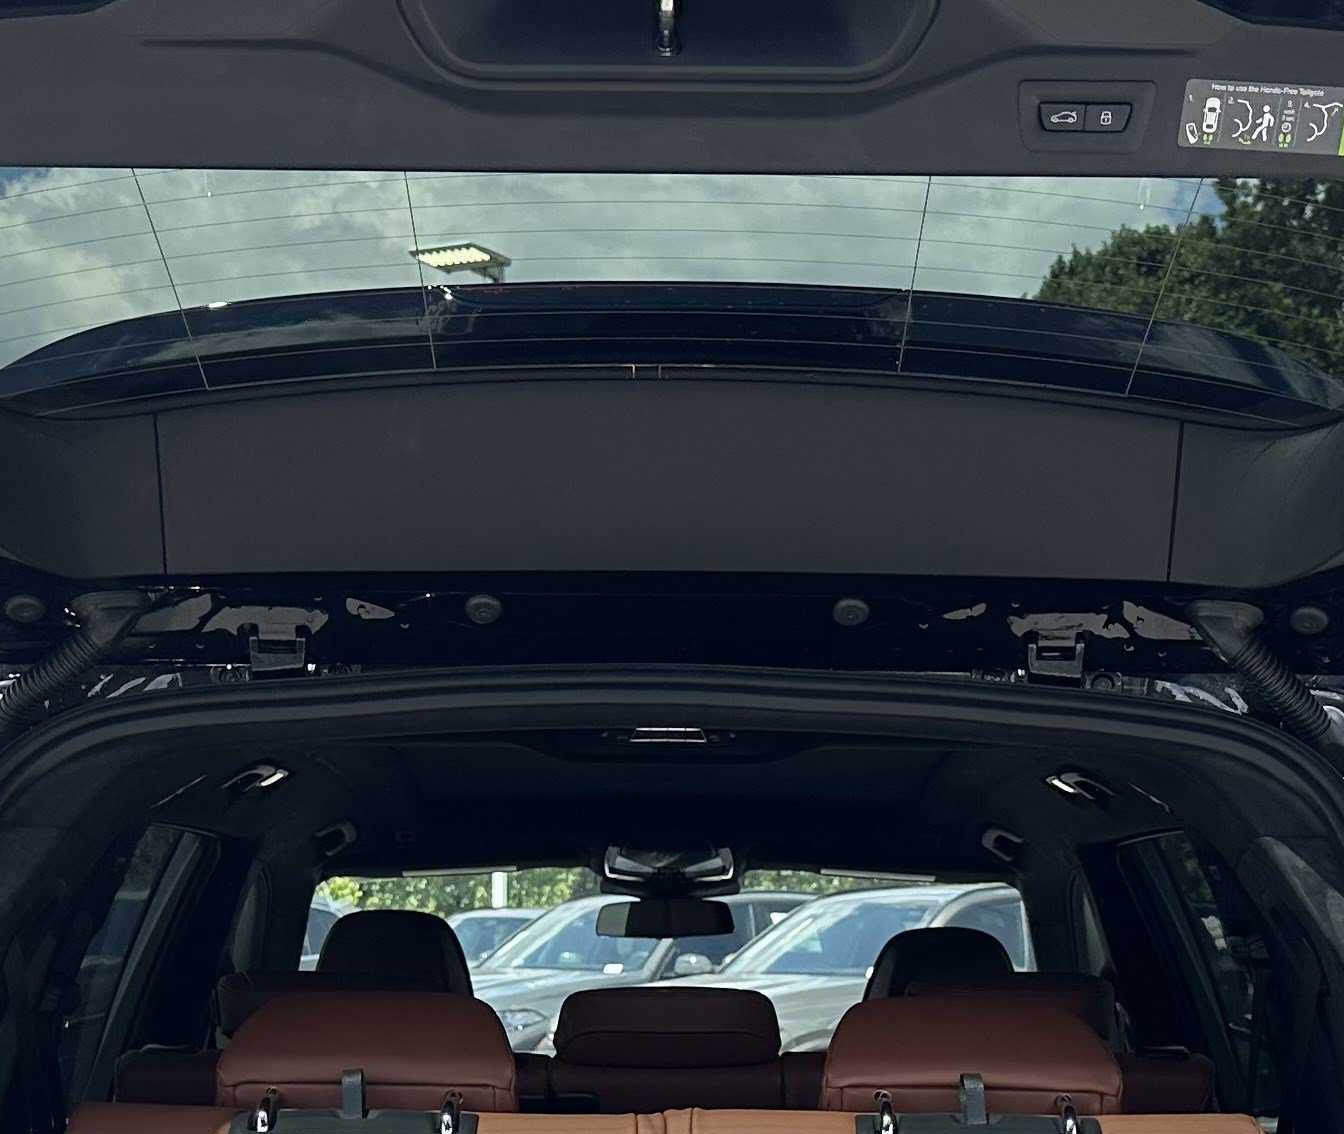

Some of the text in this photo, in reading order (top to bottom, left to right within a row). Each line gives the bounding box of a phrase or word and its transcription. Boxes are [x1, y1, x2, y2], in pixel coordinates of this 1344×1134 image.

[1212, 83, 1227, 91] How
[1227, 84, 1235, 92] to
[1260, 86, 1298, 95] Hands-Free
[1299, 88, 1325, 98] Tailgate
